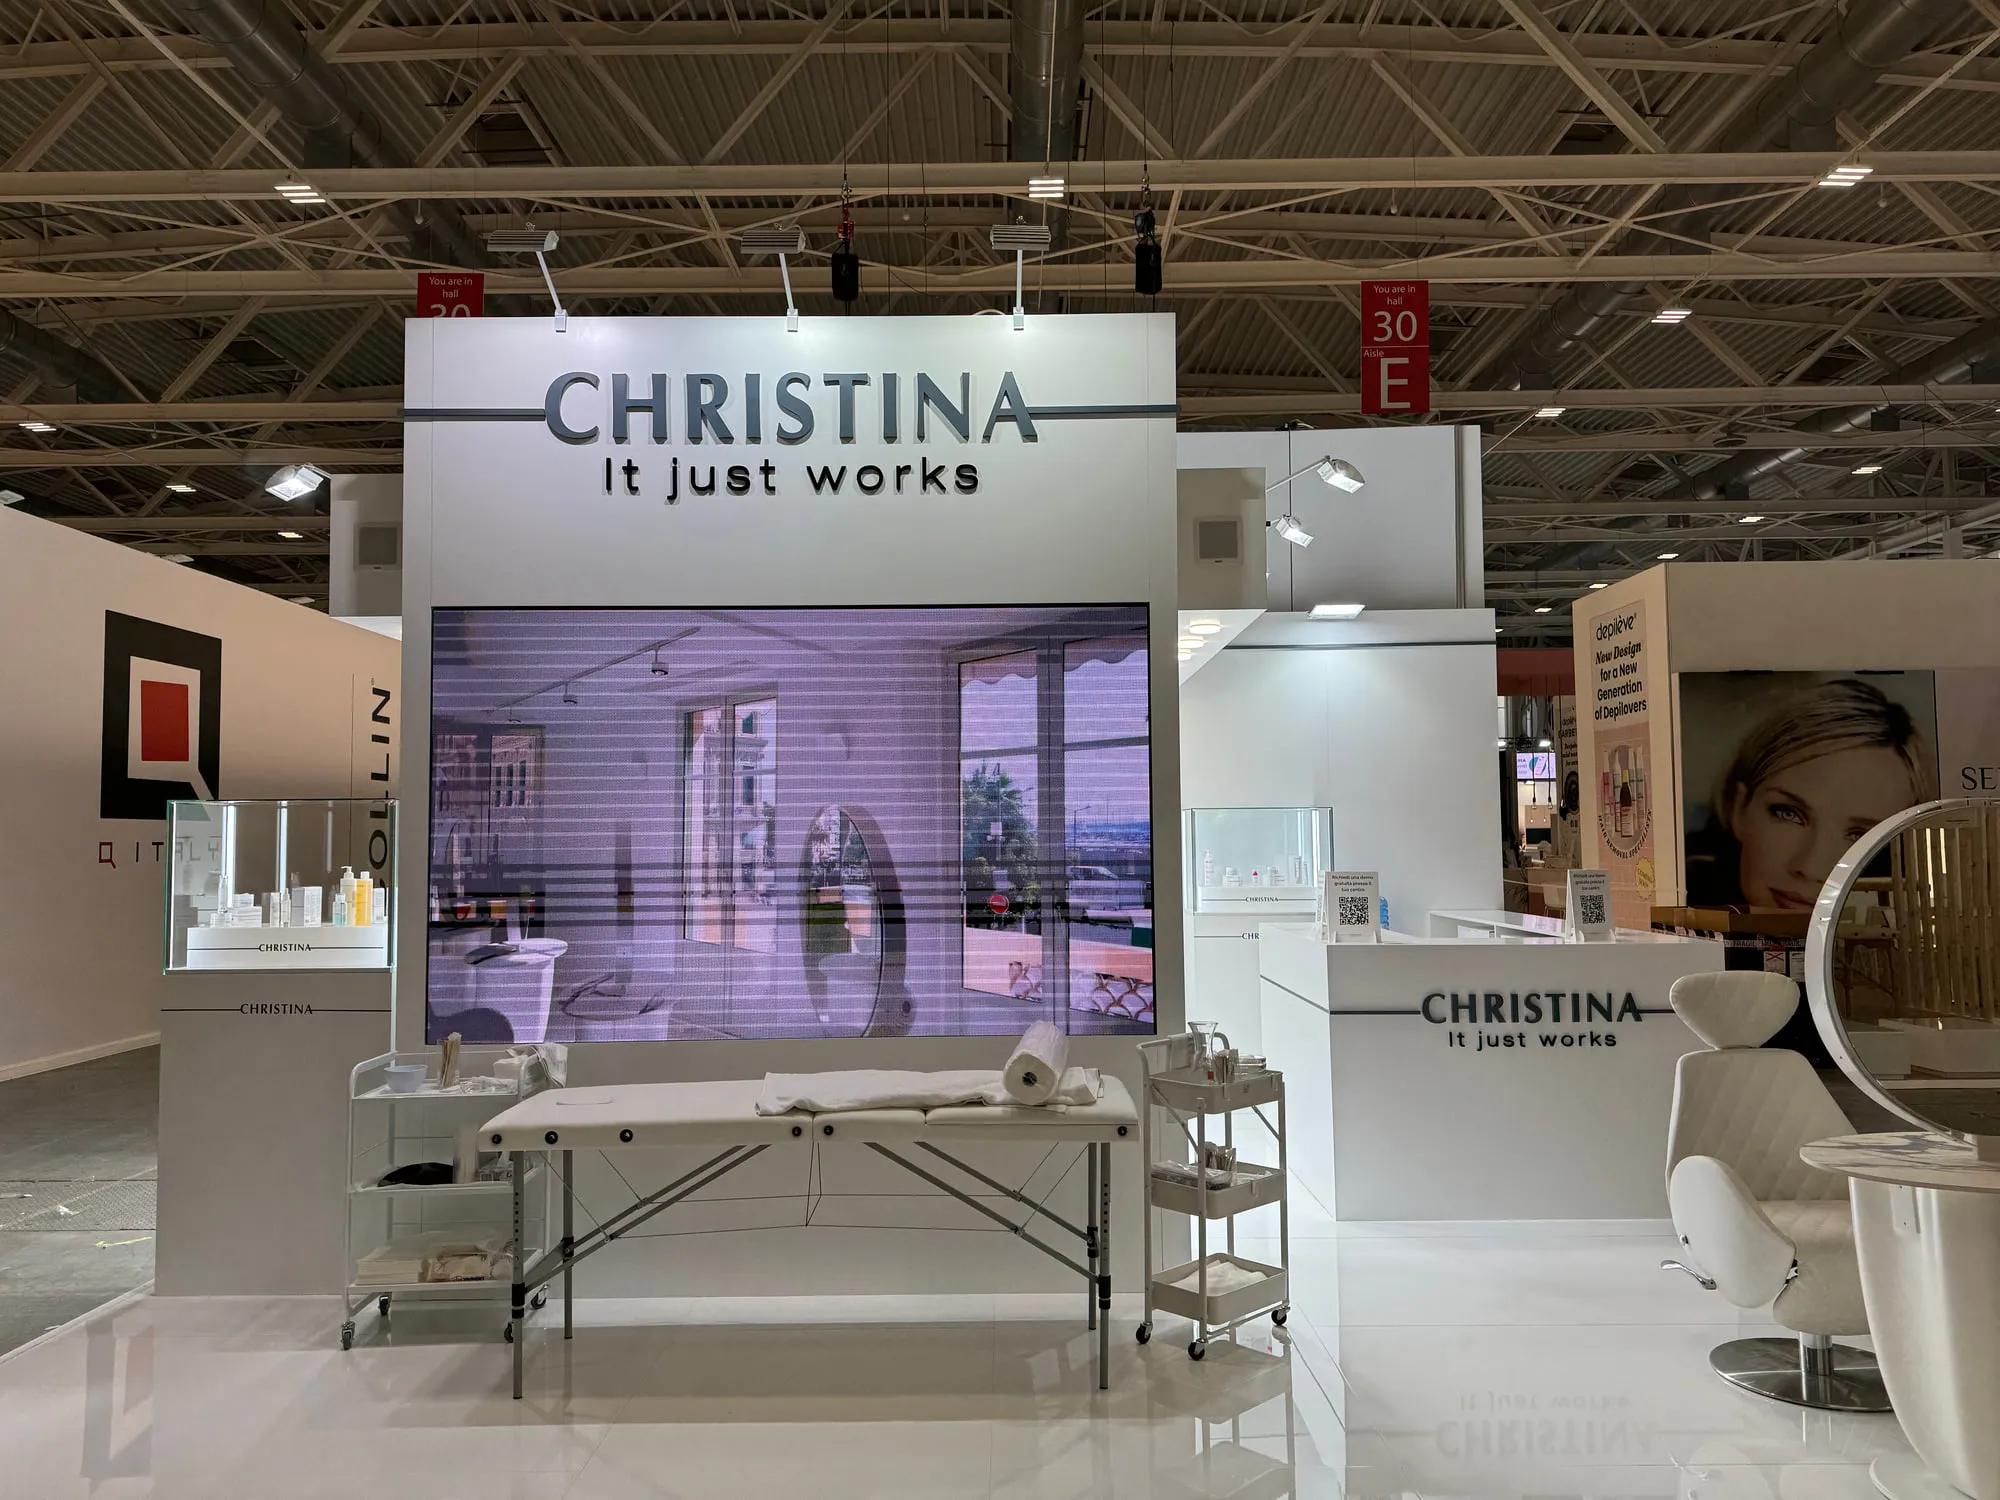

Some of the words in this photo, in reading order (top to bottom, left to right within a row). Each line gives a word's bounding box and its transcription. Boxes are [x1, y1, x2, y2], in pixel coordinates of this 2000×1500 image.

[429, 276, 446, 286] You
[447, 278, 462, 286] are
[464, 276, 473, 286] in
[1373, 285, 1390, 294] You
[1407, 285, 1416, 293] in
[442, 288, 459, 298] hall
[1386, 296, 1403, 306] hall
[1373, 310, 1418, 342] 30
[1363, 349, 1385, 358] Aisle
[1380, 357, 1411, 409] E
[545, 371, 1038, 445] CHRISTINA
[605, 457, 640, 495] It
[666, 456, 776, 505] just
[806, 456, 979, 495] works
[1595, 650, 1612, 665] New
[1613, 641, 1642, 659] Design
[1600, 668, 1611, 682] for
[1612, 667, 1618, 679] a
[1619, 661, 1638, 678] New
[1597, 680, 1643, 702] Generation
[1594, 705, 1603, 720] of
[1603, 699, 1647, 722] Depilovers
[1961, 766, 2000, 791] SE
[258, 943, 312, 952] CHRISTINA
[240, 1003, 313, 1015] CHRISTINA
[1421, 991, 1643, 1024] CHRISTINA
[1448, 1031, 1466, 1047] It
[1476, 1030, 1526, 1052] just
[1538, 1031, 1617, 1048] works
